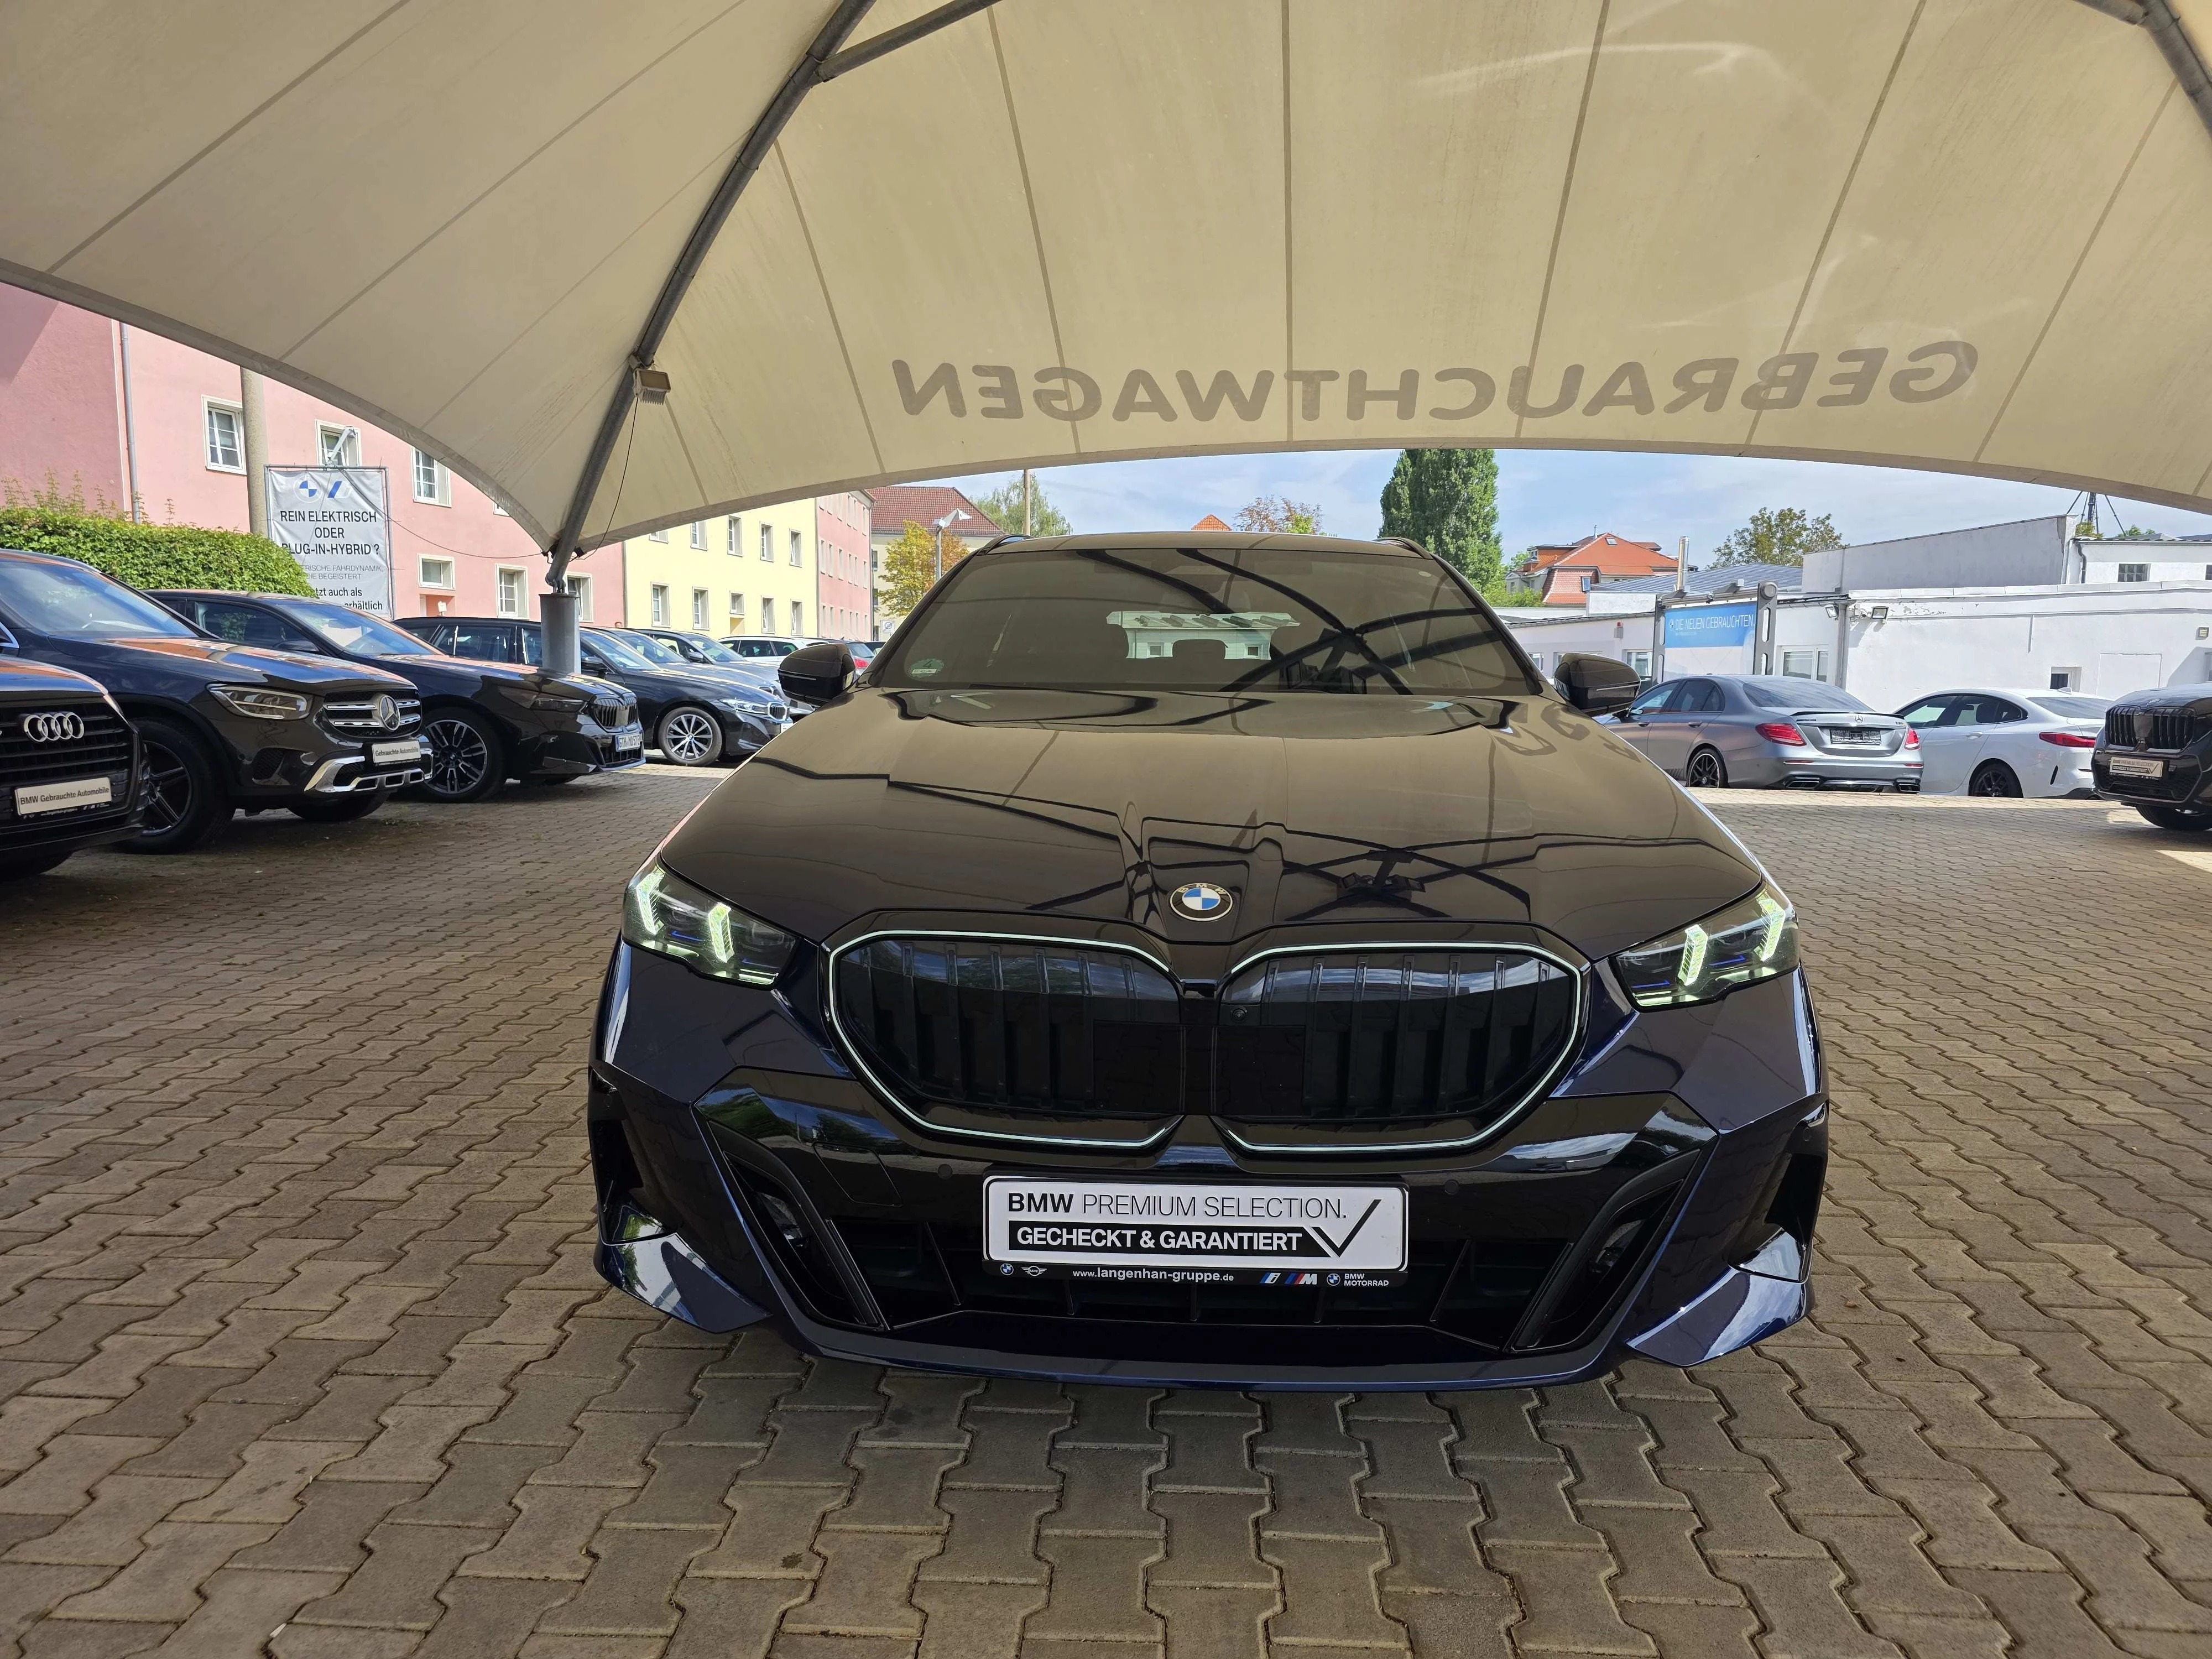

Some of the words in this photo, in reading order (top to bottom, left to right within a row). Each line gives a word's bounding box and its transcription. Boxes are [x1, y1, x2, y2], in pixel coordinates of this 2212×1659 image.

[280, 510, 305, 522] REIN
[308, 510, 377, 523] ELEKTRISCH
[314, 527, 345, 539] ODER
[328, 587, 348, 597] auch
[350, 587, 363, 597] als
[20, 795, 39, 805] BMW
[40, 791, 76, 802] Gebrauchte
[77, 787, 109, 797] Automobile
[1008, 1192, 1074, 1213] BMW
[1083, 1193, 1196, 1217] PREMIUM
[1204, 1196, 1347, 1218] SELECTION.
[1017, 1227, 1136, 1248] GECHECKT
[1140, 1230, 1155, 1248] &
[1160, 1230, 1302, 1251] GARANTIERT
[1072, 1267, 1234, 1282] www.langenhan-gruppe.de
